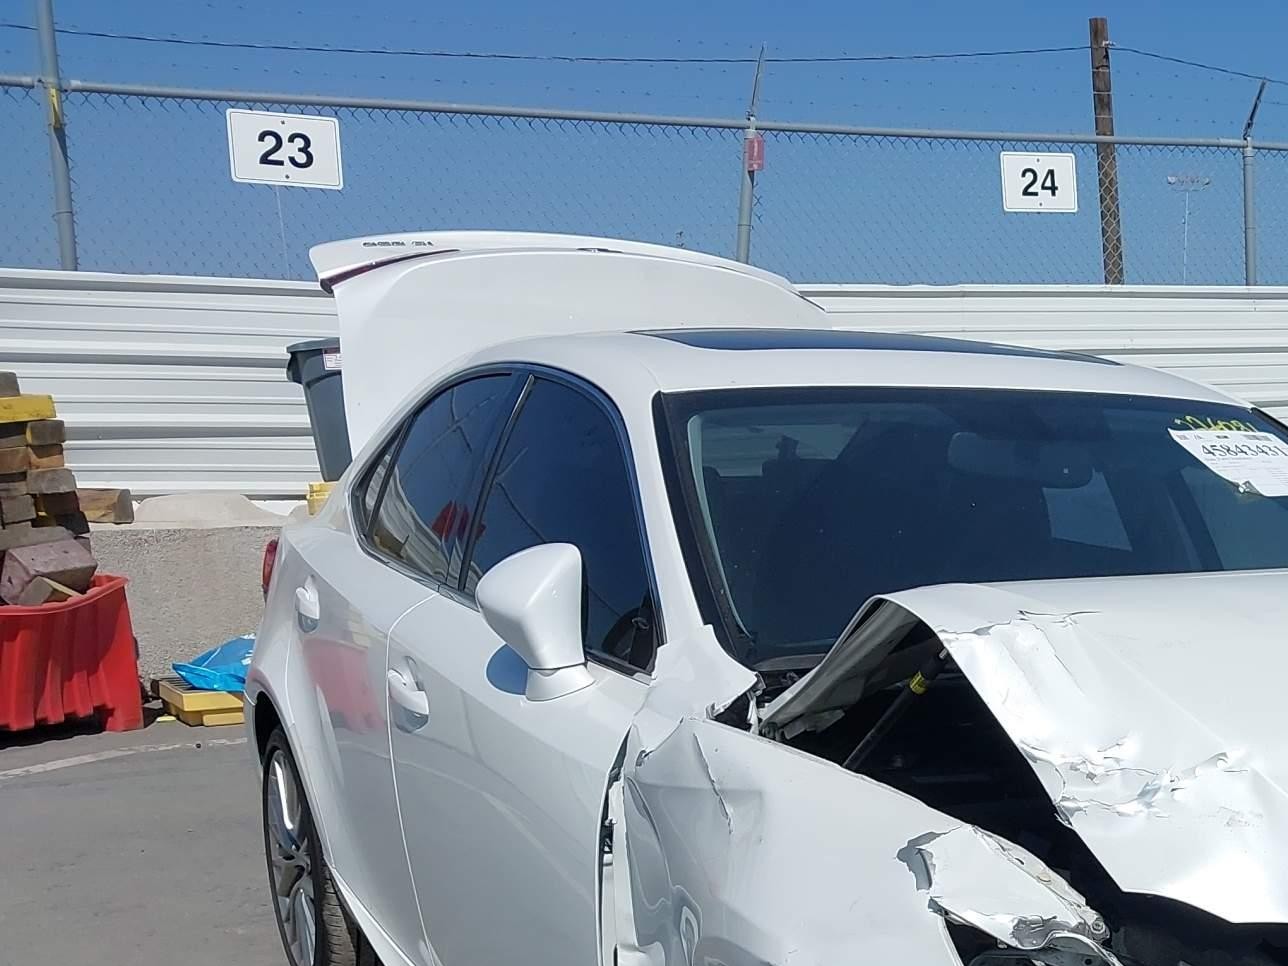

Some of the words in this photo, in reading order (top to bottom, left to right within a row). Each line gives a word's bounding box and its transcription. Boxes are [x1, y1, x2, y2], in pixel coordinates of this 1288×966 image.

[257, 130, 314, 169] 23
[1021, 167, 1059, 197] 24
[1200, 443, 1288, 458] 45843431
